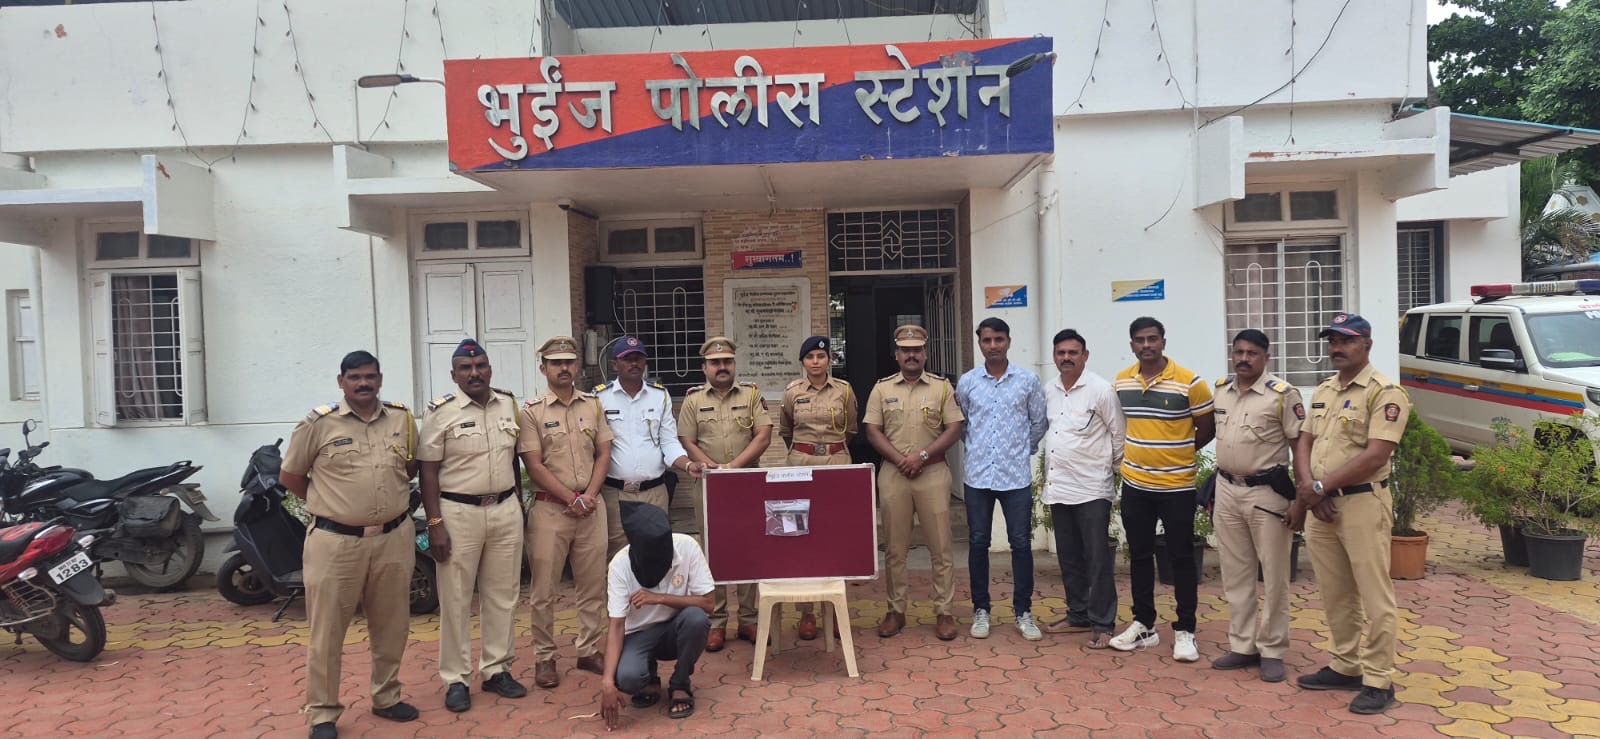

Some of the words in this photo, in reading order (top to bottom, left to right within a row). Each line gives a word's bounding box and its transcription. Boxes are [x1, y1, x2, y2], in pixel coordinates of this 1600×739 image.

[477, 56, 616, 161] भुईंज
[645, 53, 825, 132] पोलीस
[855, 44, 1011, 126] स्टेशन
[56, 559, 89, 580] 1283
